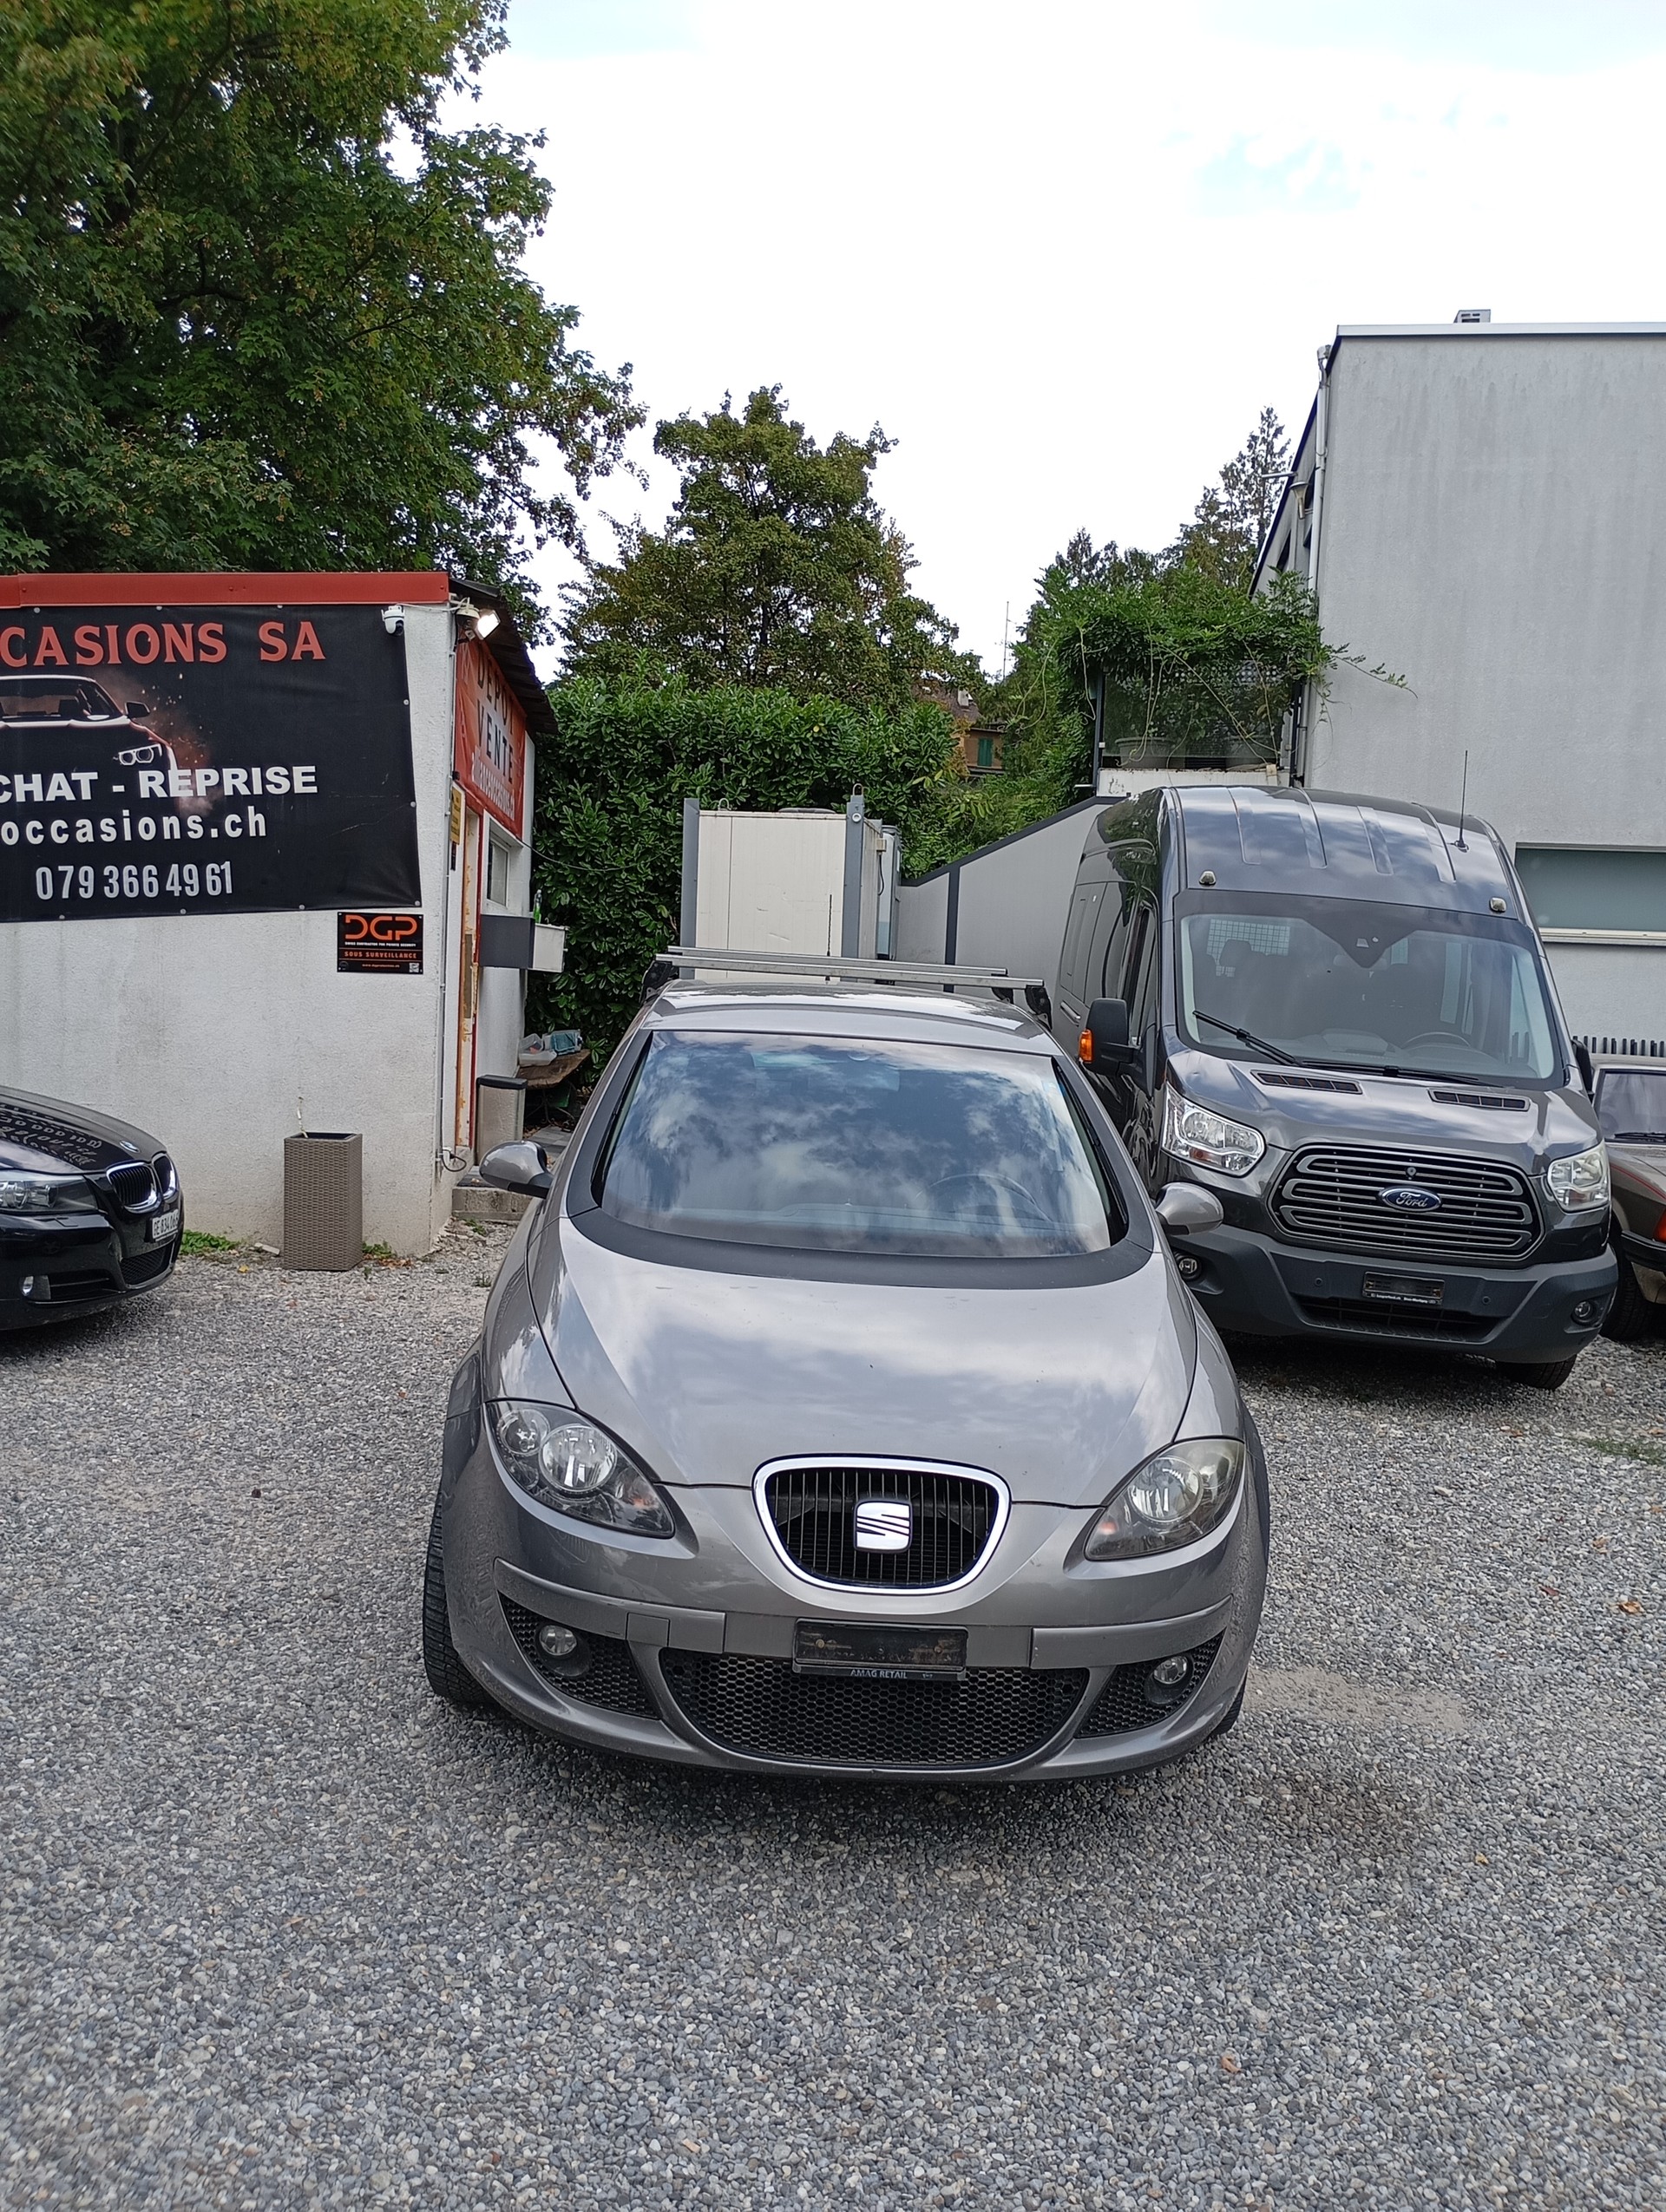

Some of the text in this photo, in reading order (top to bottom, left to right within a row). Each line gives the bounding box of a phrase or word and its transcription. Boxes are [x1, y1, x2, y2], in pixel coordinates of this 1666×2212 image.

[0, 621, 326, 667] CASIONS SA
[477, 699, 514, 784] VENTE
[139, 766, 318, 798] REPRISE
[1, 806, 266, 846] occasions.ch
[36, 861, 233, 900] 079 366 49 61
[345, 914, 417, 940] DGP
[1395, 1191, 1428, 1207] Ford
[849, 1669, 908, 1679] AMAG RETAIL
